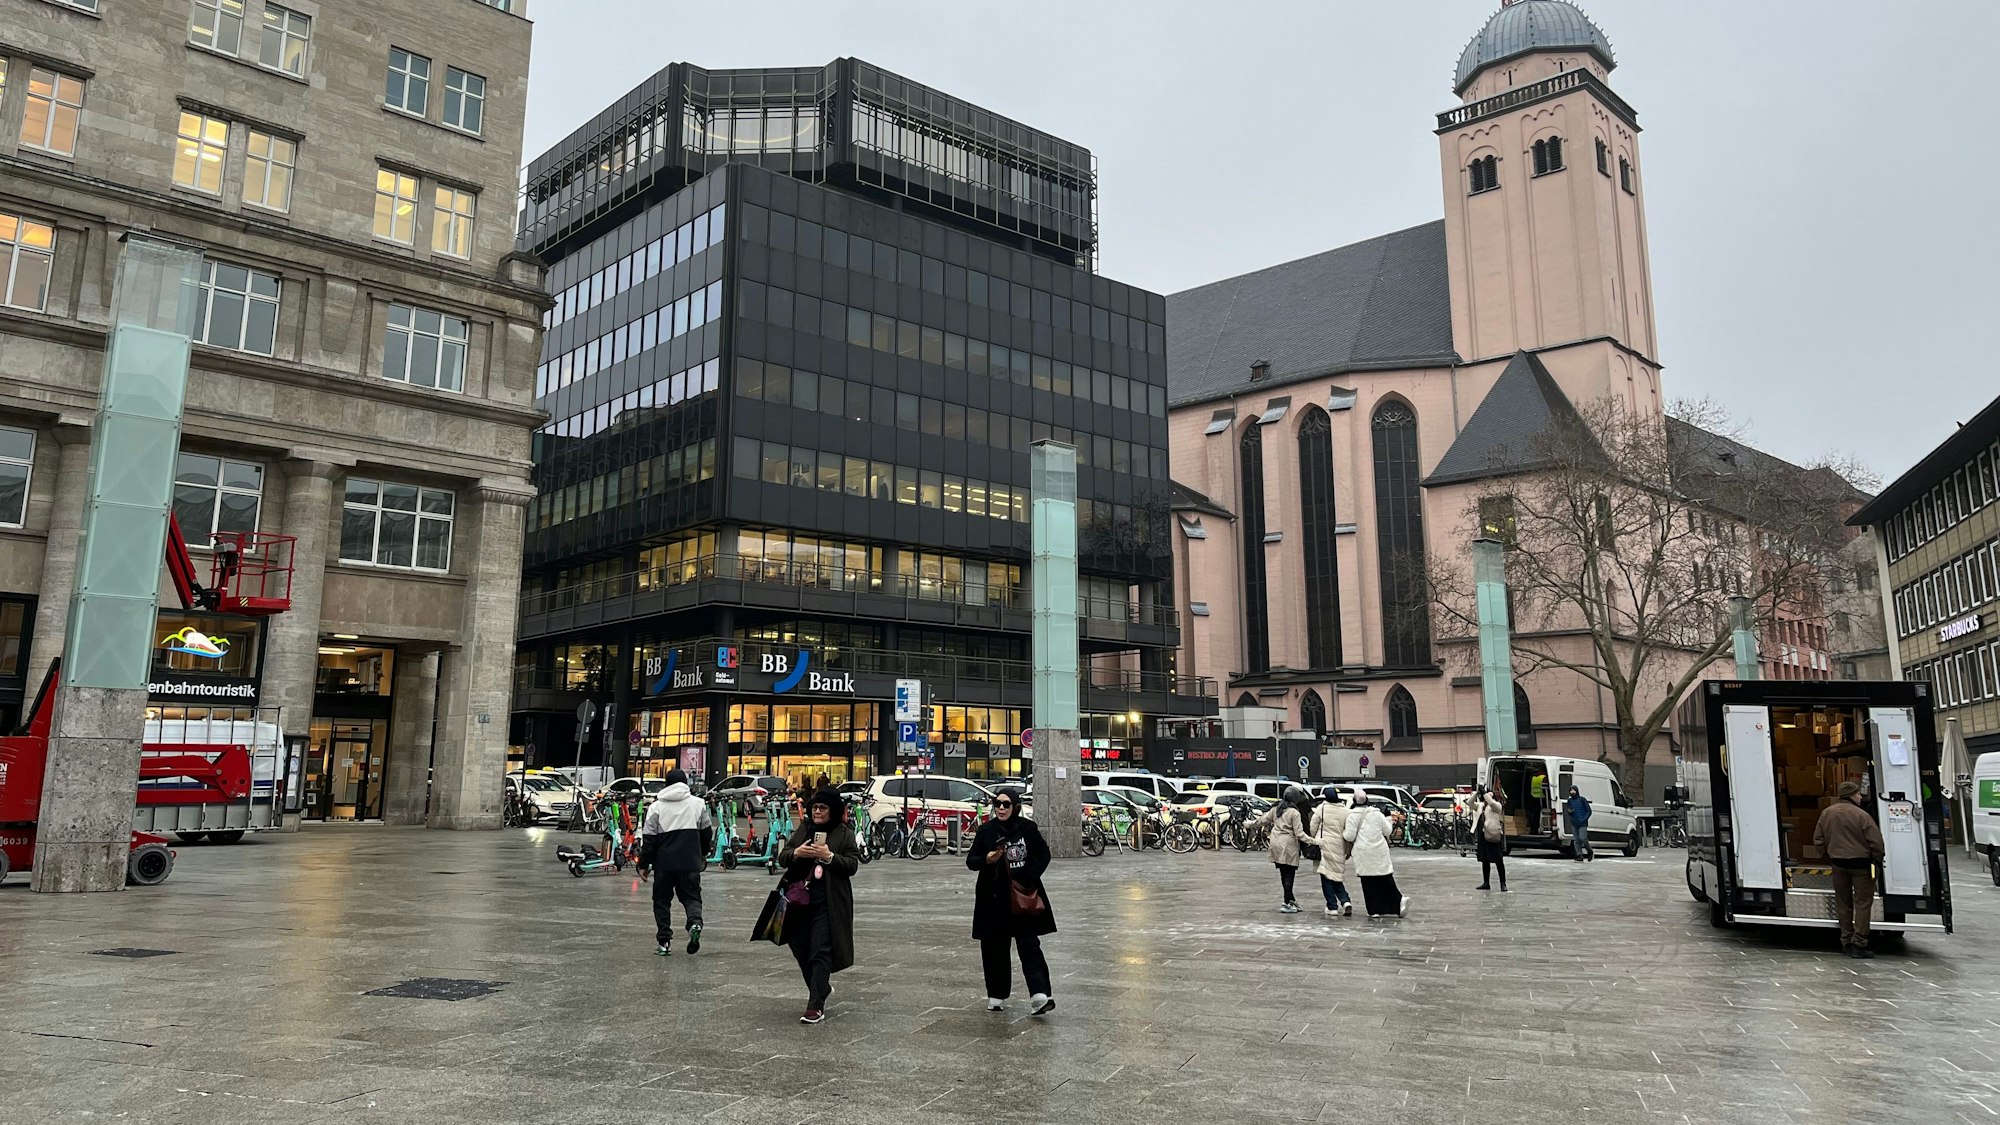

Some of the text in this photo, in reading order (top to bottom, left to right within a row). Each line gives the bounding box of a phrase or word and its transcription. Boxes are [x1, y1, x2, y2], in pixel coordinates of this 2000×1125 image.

[1941, 614, 1979, 641] STARBUCKS
[645, 657, 703, 688] BB Bank
[761, 653, 855, 692] BB Bank
[148, 681, 256, 697] enbahntouristik
[903, 725, 913, 741] P
[1095, 750, 1106, 759] AM
[1188, 751, 1215, 759] BISTRO
